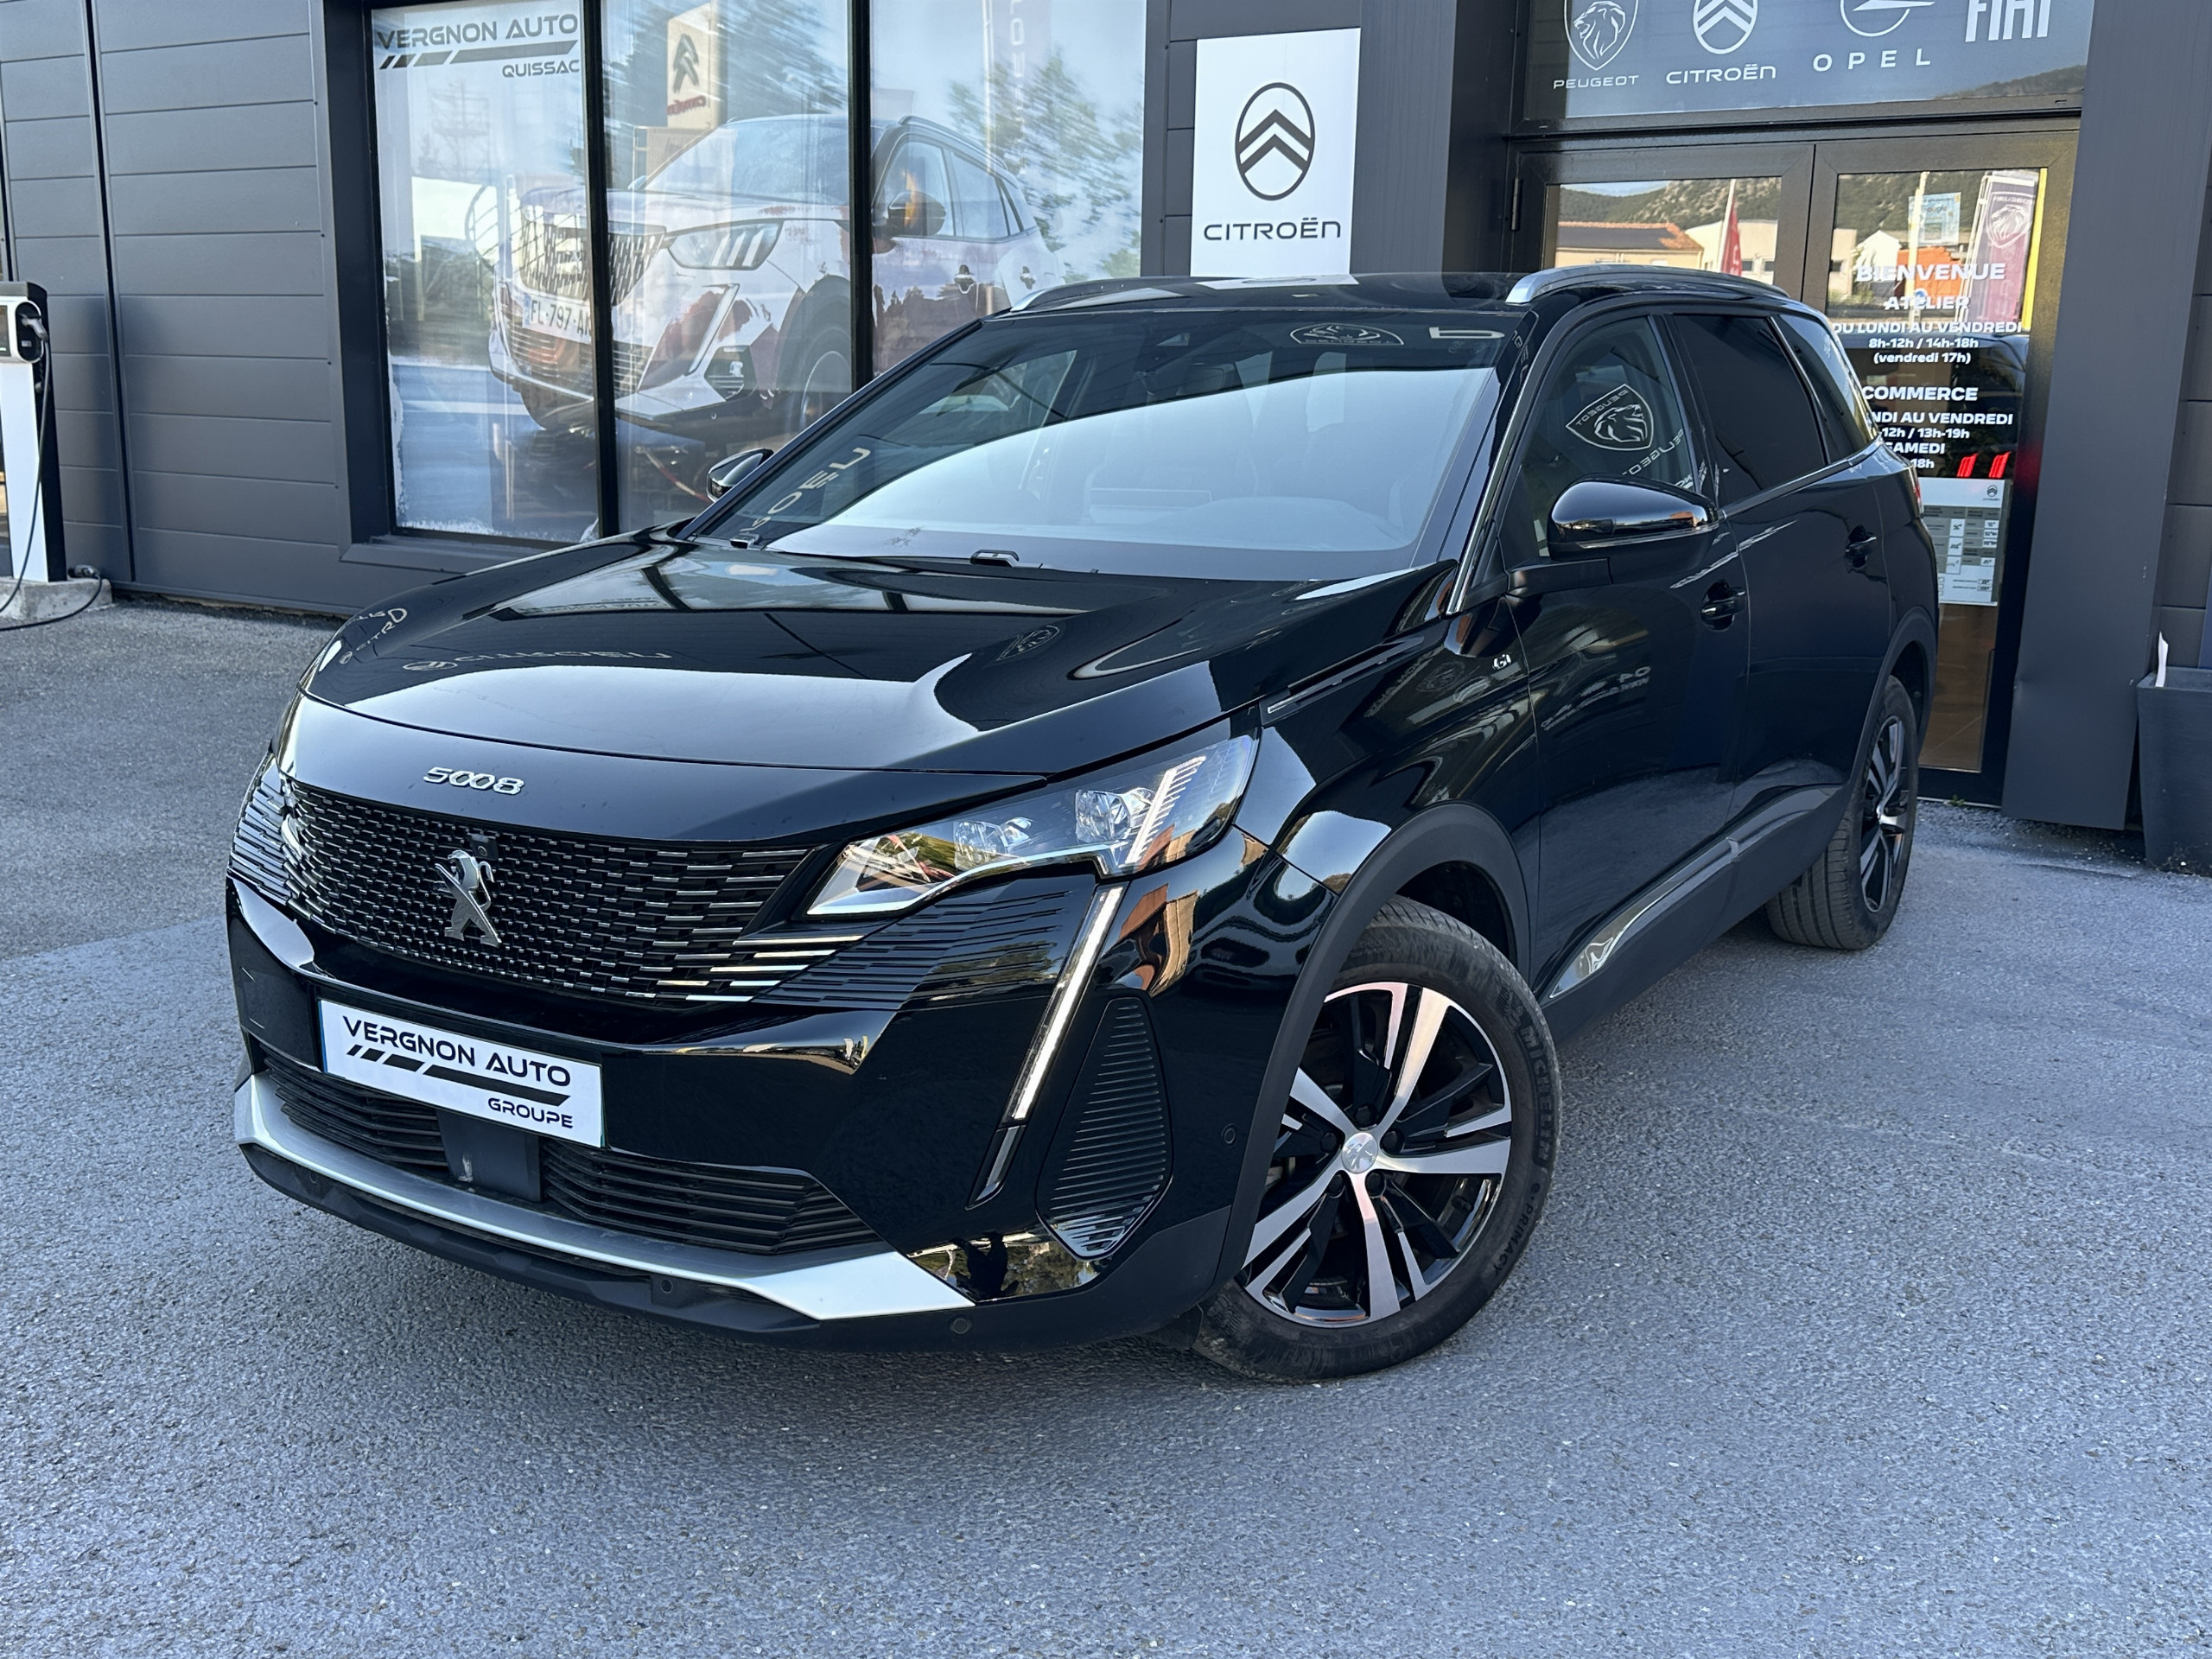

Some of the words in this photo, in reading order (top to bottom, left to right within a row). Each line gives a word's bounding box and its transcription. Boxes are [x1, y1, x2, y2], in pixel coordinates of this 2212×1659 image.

[376, 21, 497, 49] VERGNON
[505, 13, 579, 40] AUTO
[1813, 48, 1931, 72] OPEL
[501, 59, 580, 79] QUISSAC
[1554, 75, 1639, 89] PEUGEOT
[1856, 263, 2005, 282] BIENVENUE
[1885, 296, 1971, 310] ATELIER
[1833, 323, 1854, 334] DU
[1858, 322, 1904, 334] LUNDI
[1909, 322, 1935, 334] AU
[1938, 321, 2022, 334] VENDREDI
[1868, 338, 1914, 349] 8h-12h
[1916, 338, 1923, 350] /
[1926, 338, 1980, 349] 14h-18h
[1873, 352, 1939, 365] (vendredi
[1941, 353, 1972, 365] 17h)
[1863, 386, 1979, 401] COMMERCE
[1872, 411, 1898, 423] NDI
[1901, 412, 1926, 423] AU
[1928, 412, 2014, 425] VENDREDI
[1908, 428, 1916, 440] /
[1917, 429, 1971, 439] 13h-19h
[1911, 458, 1936, 469] 18h
[423, 766, 524, 795] 5008
[342, 1015, 476, 1067] VERGNON
[486, 1052, 571, 1087] AUTO
[1519, 1025, 1554, 1160] MICHELIN
[487, 1097, 574, 1129] GROUPE
